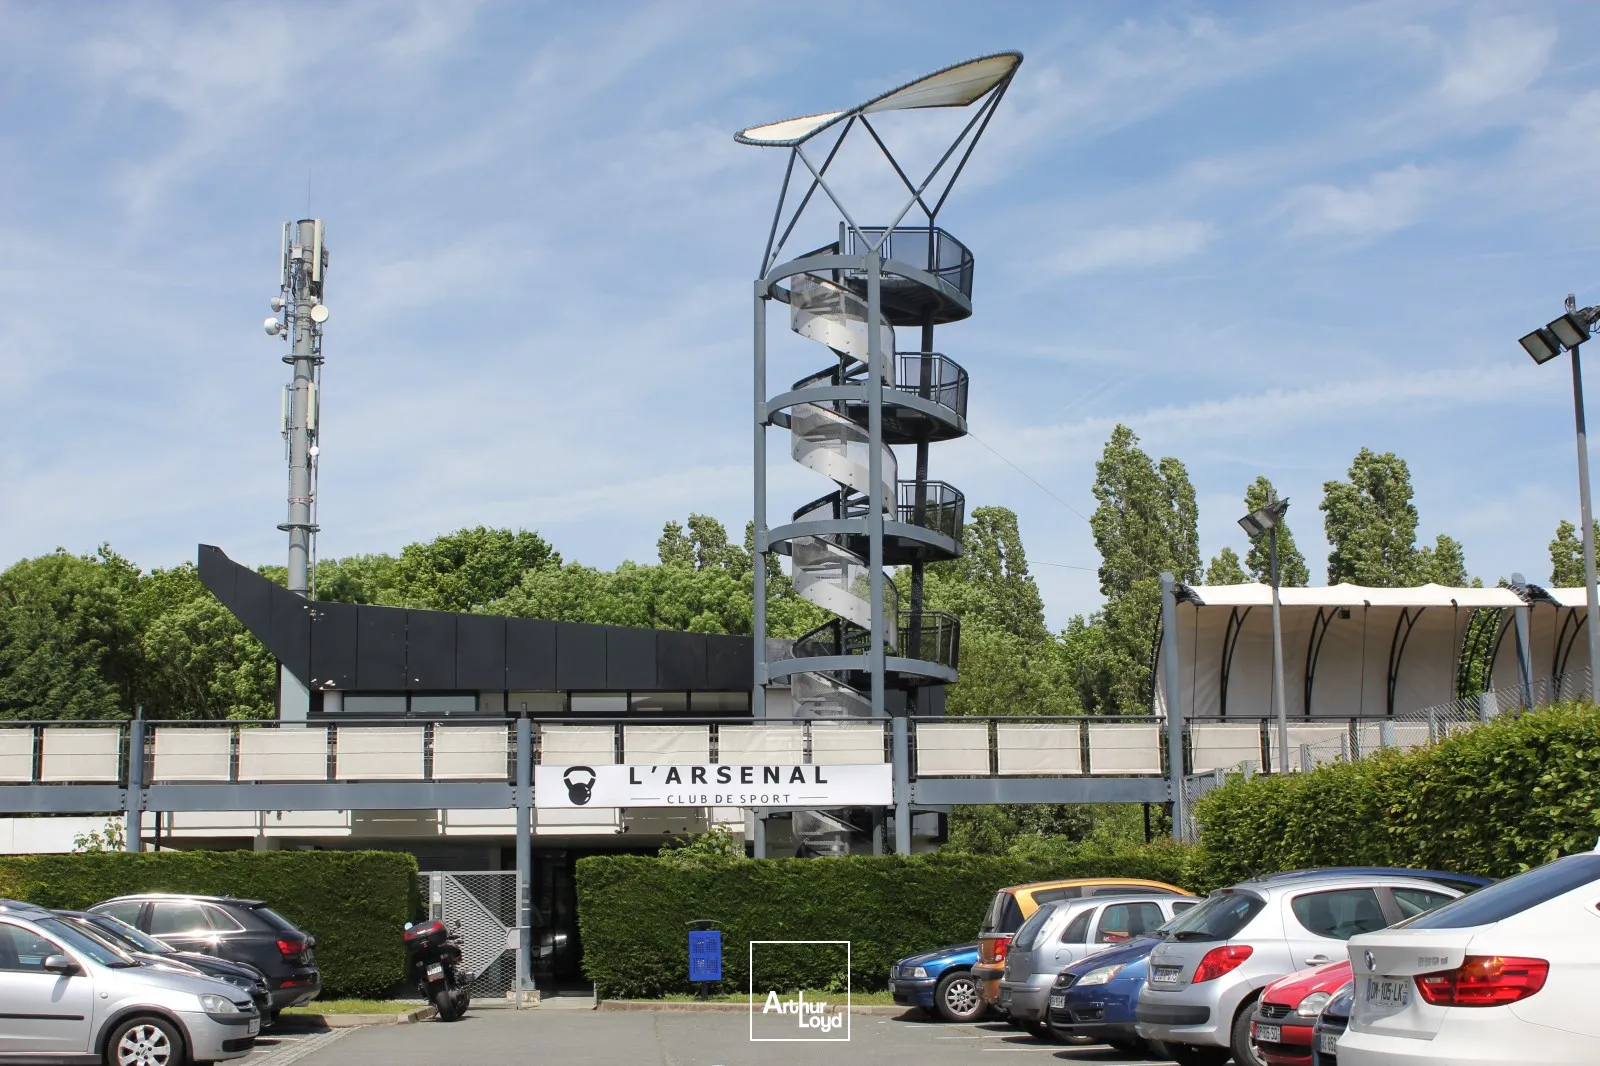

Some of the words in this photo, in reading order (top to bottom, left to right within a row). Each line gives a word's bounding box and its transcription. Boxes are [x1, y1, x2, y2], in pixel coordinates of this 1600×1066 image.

[629, 765, 828, 785] L'ARSENAL
[666, 794, 708, 804] CLUB
[715, 794, 734, 804] DE
[740, 794, 791, 804] SPORT
